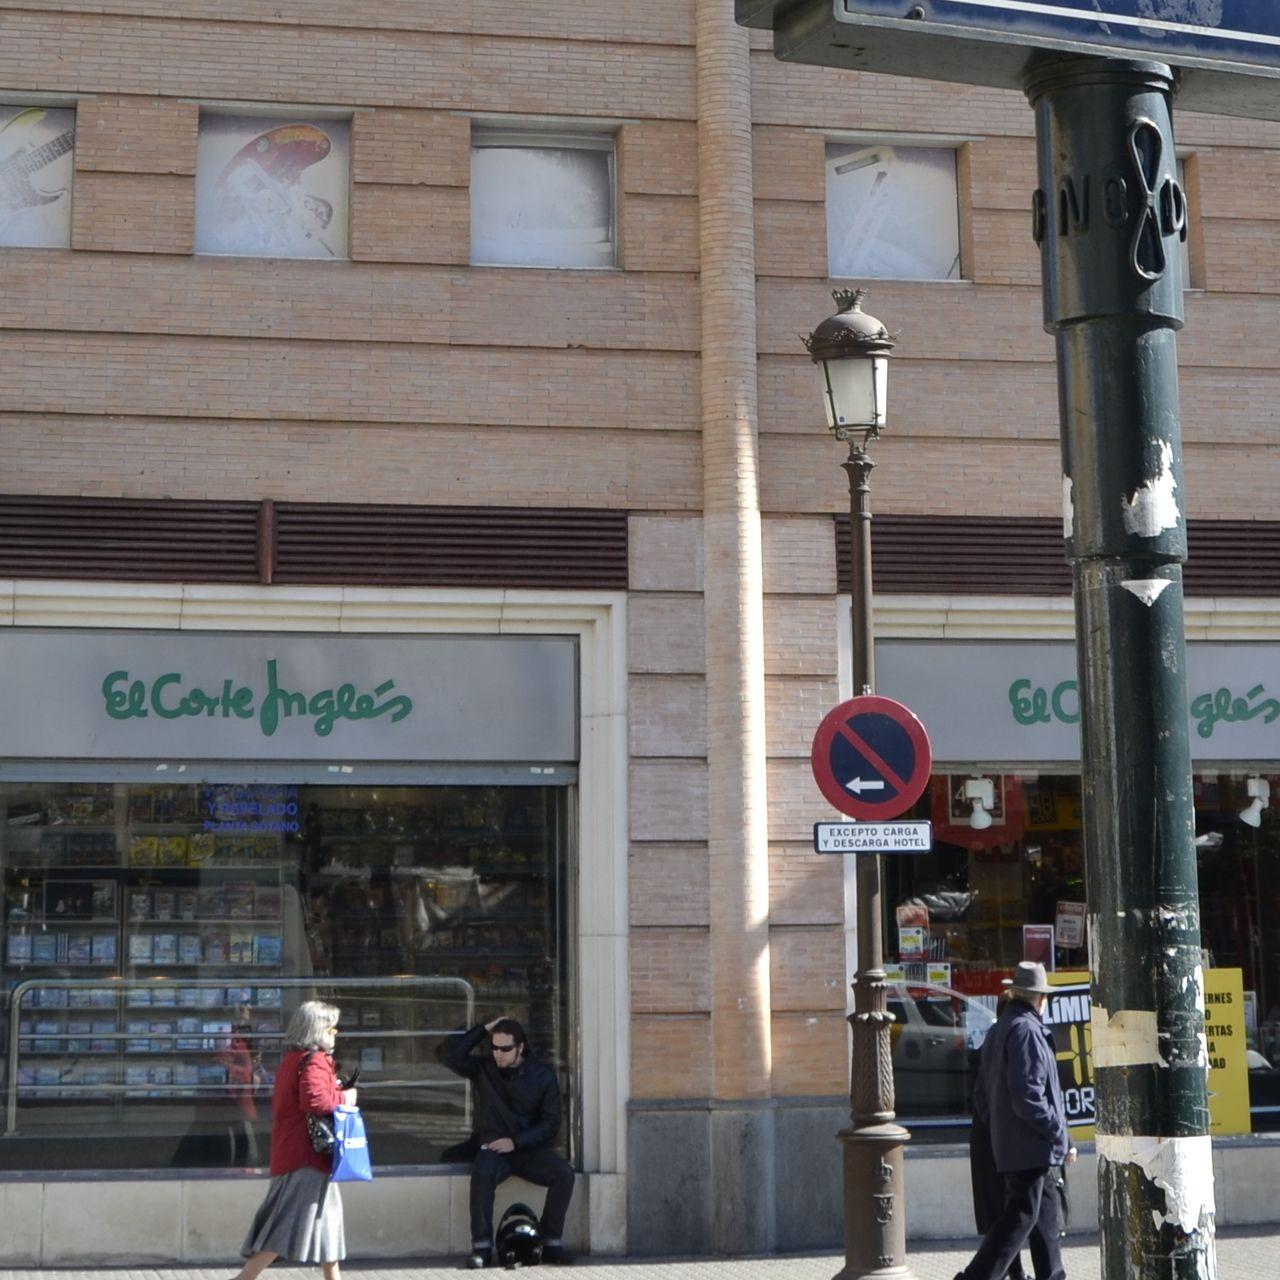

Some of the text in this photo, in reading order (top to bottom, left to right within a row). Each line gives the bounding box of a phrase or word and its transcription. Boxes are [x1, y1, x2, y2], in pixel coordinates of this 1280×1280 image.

[102, 659, 413, 736] El Corte Inglés
[1008, 679, 1051, 725] El
[823, 838, 926, 847] Y DESCARGA HOTEL
[829, 827, 919, 837] EXCEPTO CARGA
